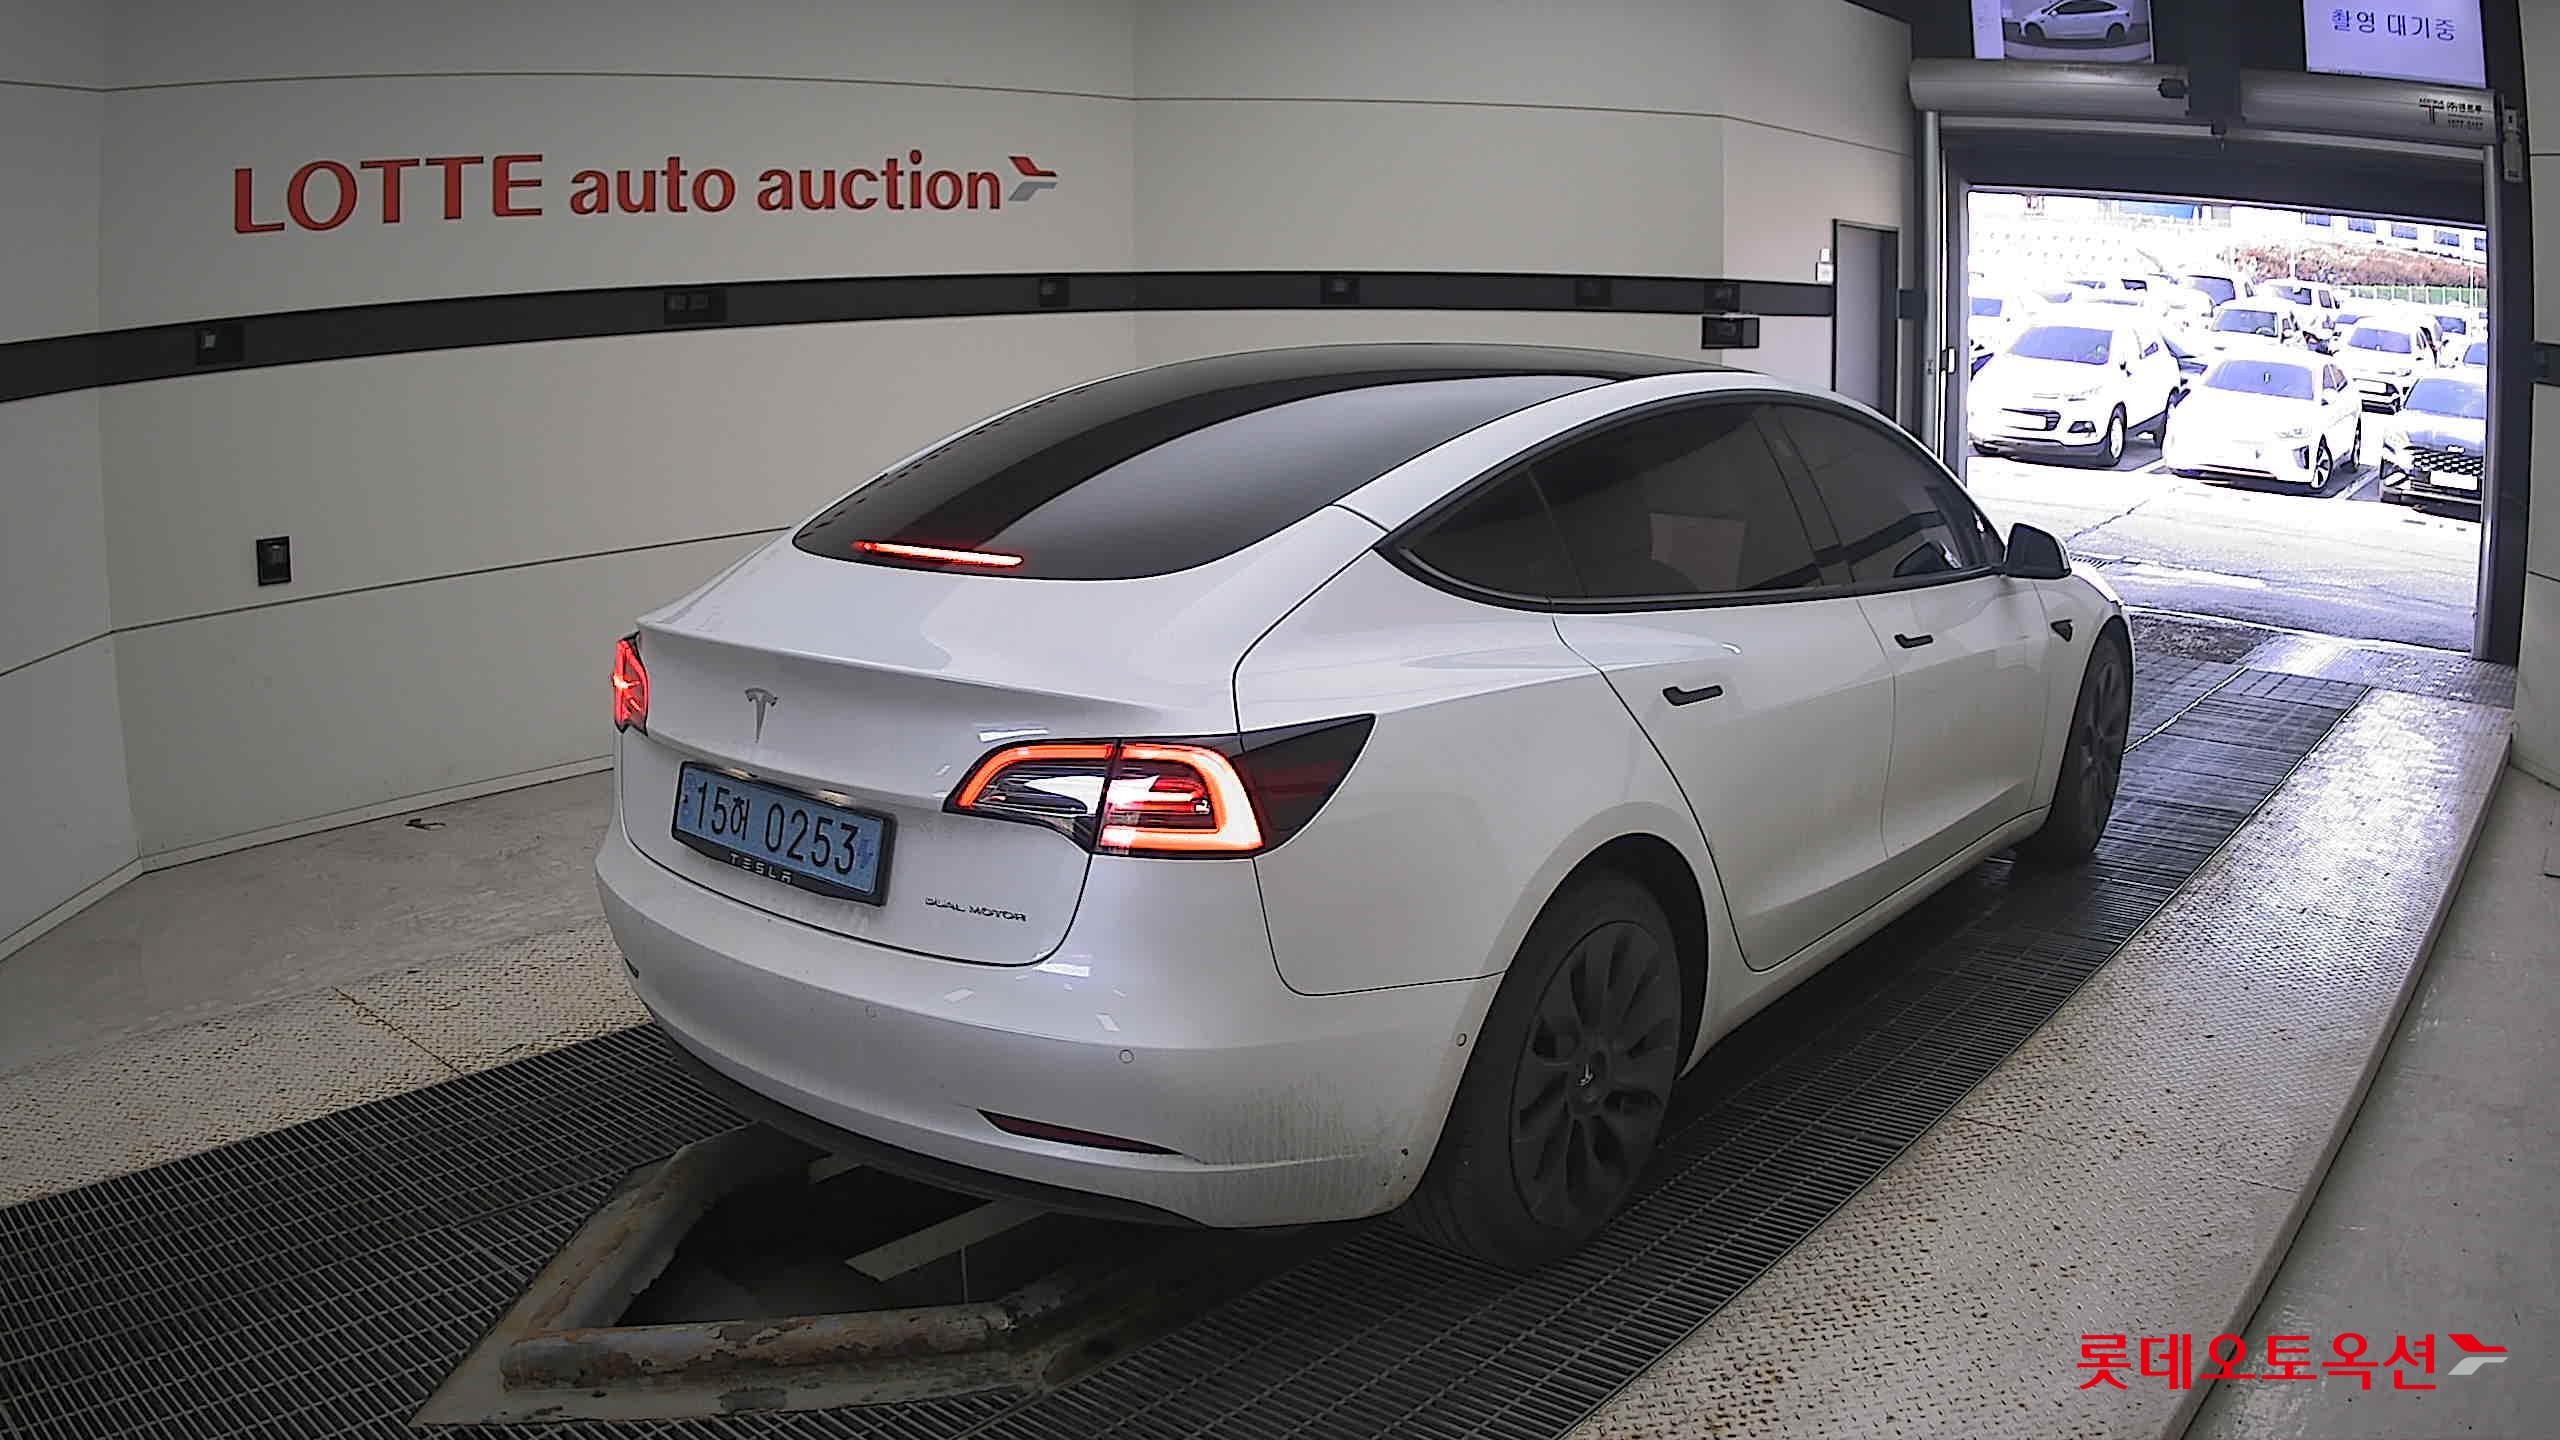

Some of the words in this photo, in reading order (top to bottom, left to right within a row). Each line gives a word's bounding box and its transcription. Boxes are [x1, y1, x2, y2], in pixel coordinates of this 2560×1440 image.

[2387, 13, 2456, 42] 대기중
[233, 154, 544, 234] LOTTE
[568, 155, 736, 216] auto
[757, 149, 1001, 212] auction
[764, 802, 860, 875] 0253
[729, 852, 793, 885] TESLA
[925, 896, 966, 913] DUAL
[968, 904, 1027, 922] MOTOR
